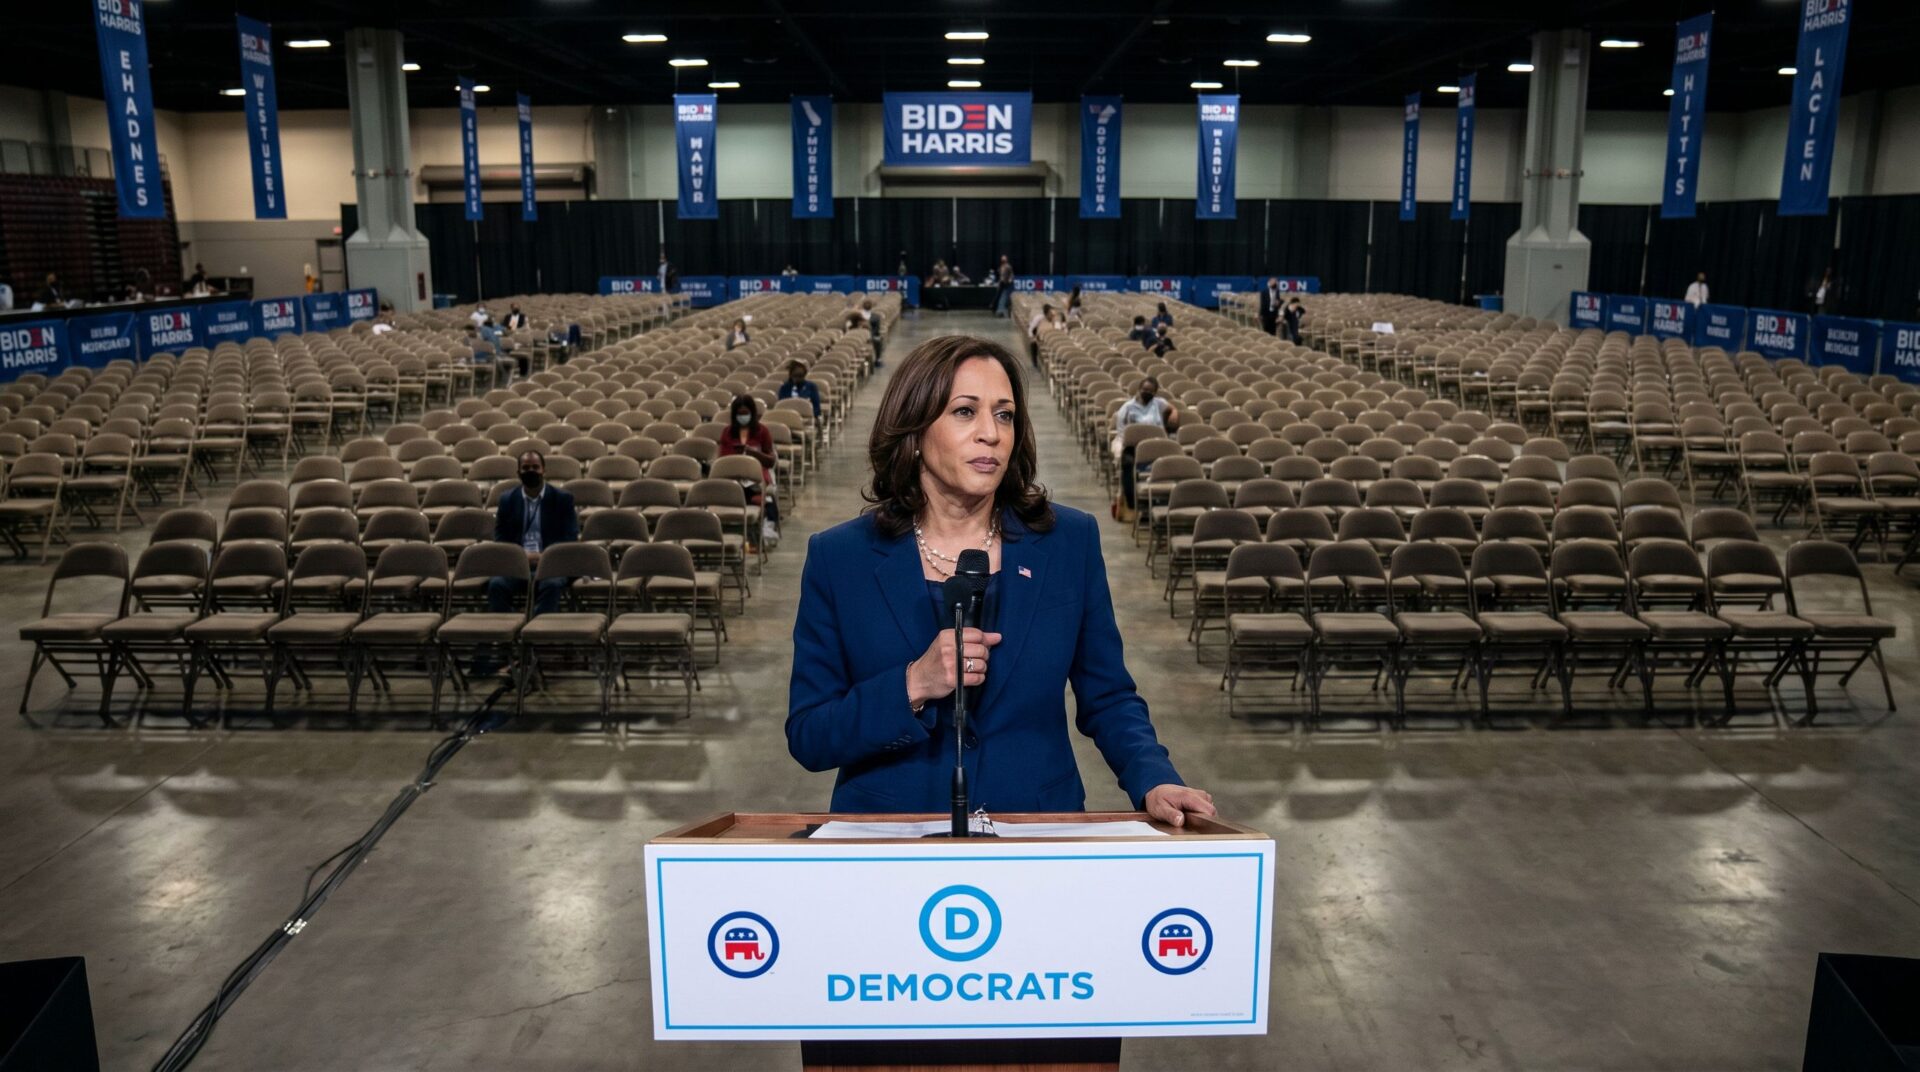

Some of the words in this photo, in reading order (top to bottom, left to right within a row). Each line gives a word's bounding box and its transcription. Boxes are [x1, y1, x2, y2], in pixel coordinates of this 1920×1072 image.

[100, 11, 141, 35] HARRIS
[1804, 8, 1847, 32] HARRIS
[1678, 31, 1708, 52] BIDEN
[678, 104, 713, 114] BIDEN
[902, 104, 1013, 130] BIDEN
[1201, 104, 1236, 114] BIDEN
[1800, 47, 1824, 182] LACIEN
[120, 50, 148, 207] EHADNES
[1675, 73, 1694, 196] HITTTS
[902, 132, 1014, 154] HARRIS
[611, 280, 652, 291] BIDEN
[739, 279, 781, 290] BIDEN
[866, 279, 908, 290] BIDEN
[1140, 279, 1181, 290] BIDEN
[1279, 280, 1307, 291] DEN
[262, 301, 294, 318] BIDEN
[1655, 303, 1685, 321] BIDEN
[150, 312, 191, 332] BIDEN
[263, 315, 295, 331] HARRIS
[1653, 318, 1684, 334] HARRIS
[1756, 314, 1796, 335] BIDEN
[0, 326, 56, 351] BIDEN
[152, 328, 194, 347] HARRIS
[1754, 331, 1795, 351] HARRIS
[2, 346, 58, 368] HARRIS
[945, 907, 979, 940] D
[827, 972, 1095, 1001] DEMOCRATS
